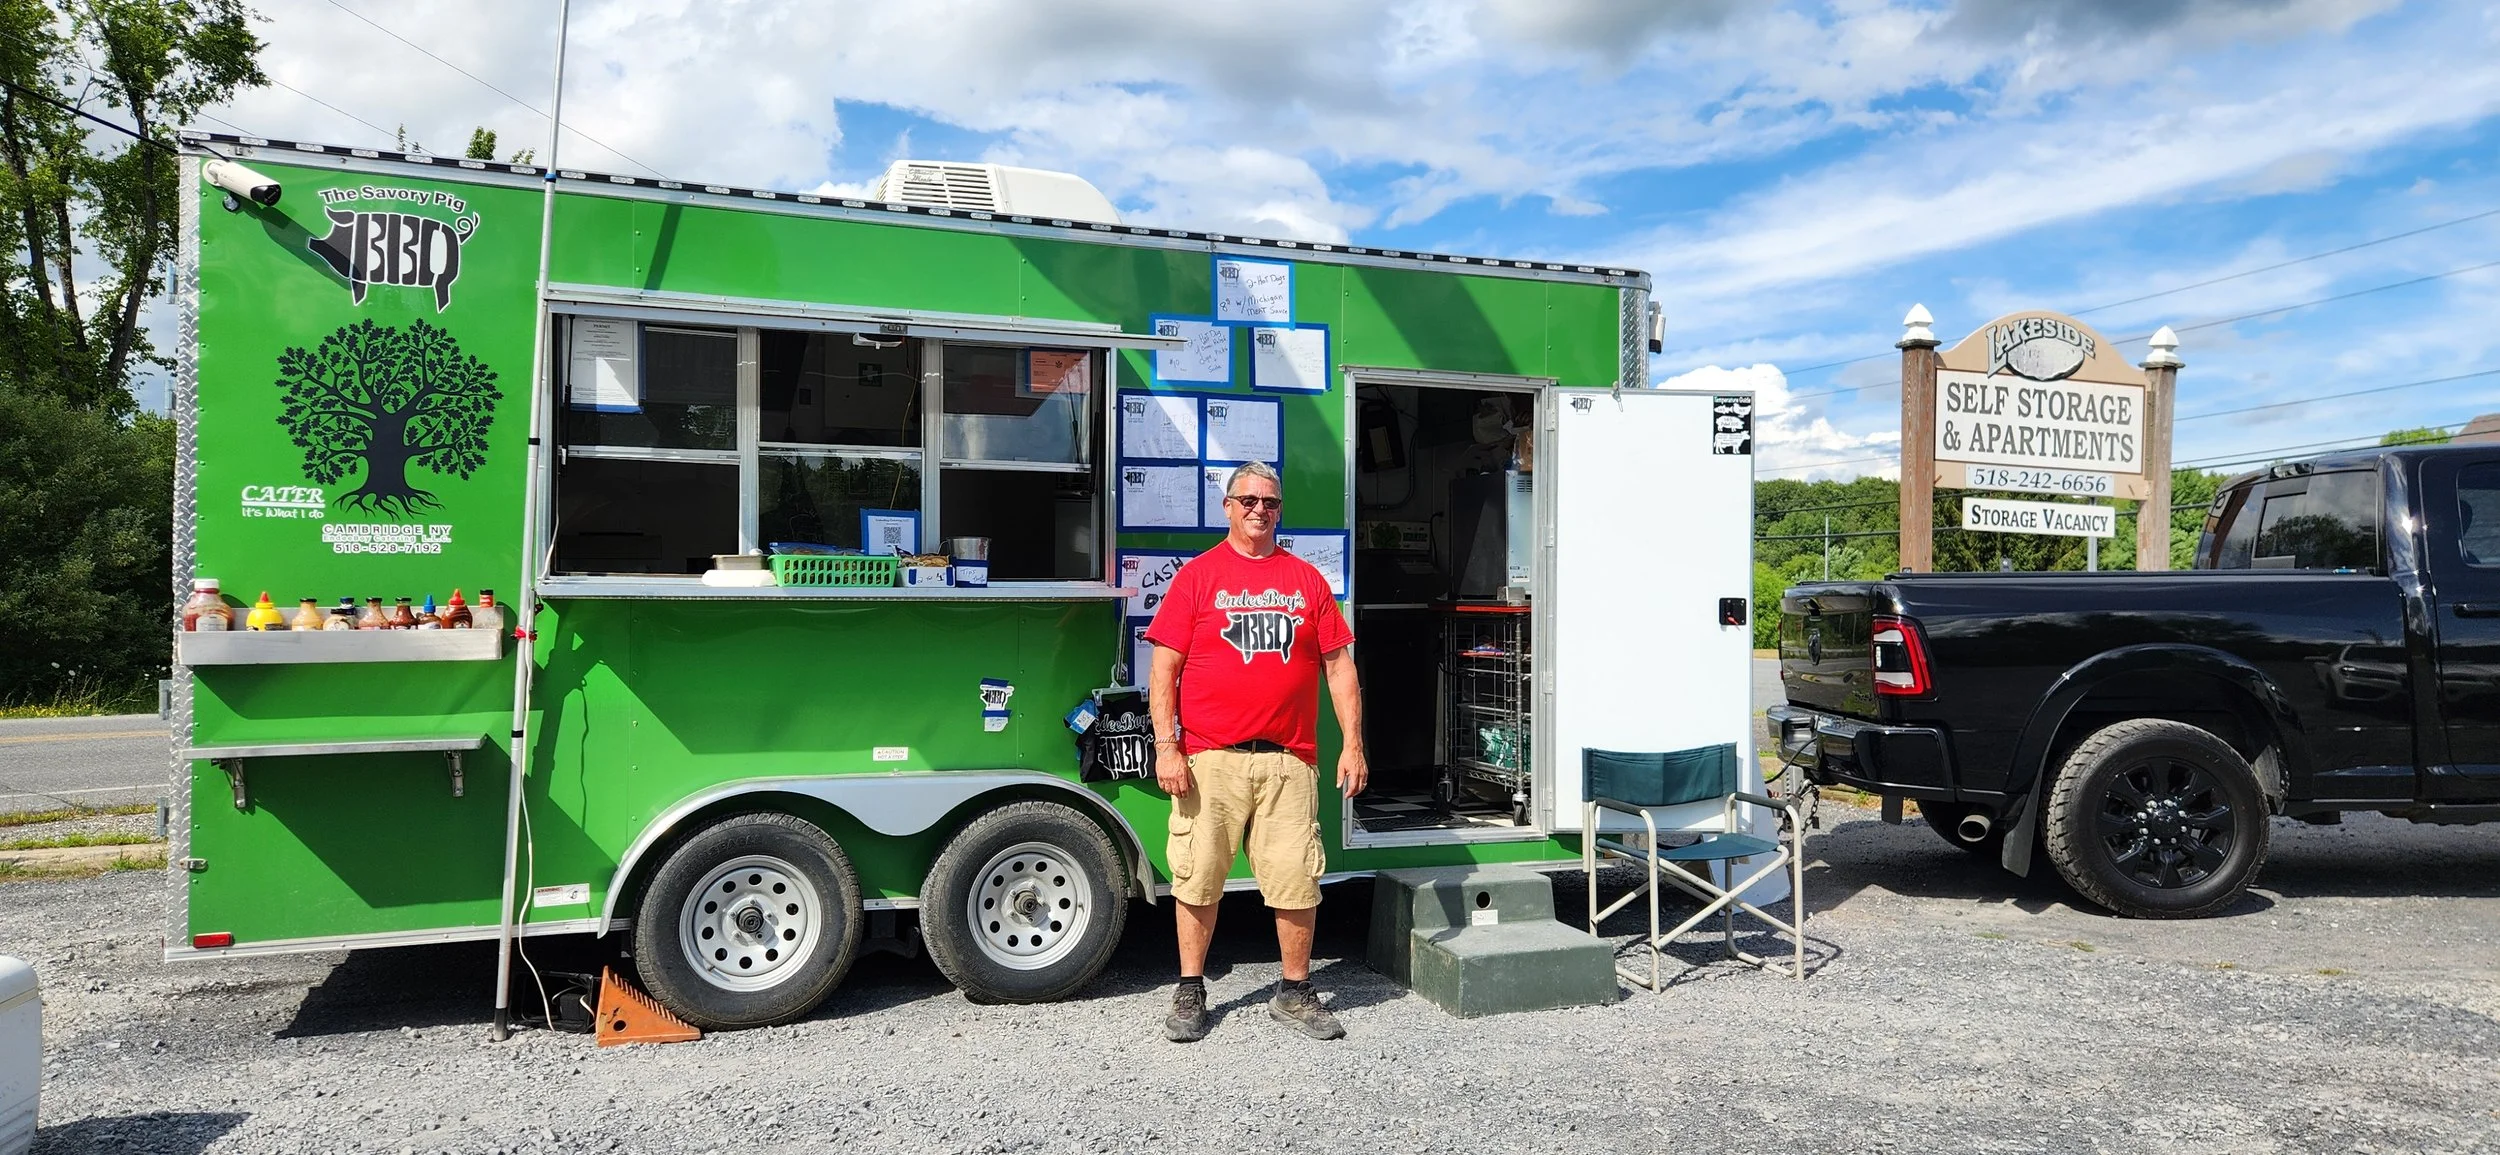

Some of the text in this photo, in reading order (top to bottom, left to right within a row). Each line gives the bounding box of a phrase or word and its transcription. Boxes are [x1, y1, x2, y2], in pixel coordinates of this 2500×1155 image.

[320, 185, 466, 213] The Savory Pig
[353, 212, 461, 313] BBQ
[1248, 294, 1283, 306] Michigan
[1986, 318, 2096, 378] LAKESIDE
[1946, 382, 2132, 425] SELF STORAGE
[1943, 420, 2134, 463] & APARTMENTS
[1973, 468, 2106, 493] 518-242-6656
[241, 485, 325, 503] CATER
[242, 508, 263, 518] It's
[266, 508, 298, 519] What
[308, 508, 324, 519] do
[1971, 504, 2109, 532] STORAGE VACANCY
[322, 524, 453, 536] CAMBRIDGE NY
[373, 534, 416, 543] Catering
[333, 543, 442, 554] 518-528-7192
[1142, 556, 1183, 588] CASH
[1215, 588, 1306, 612] EndeeBoy's
